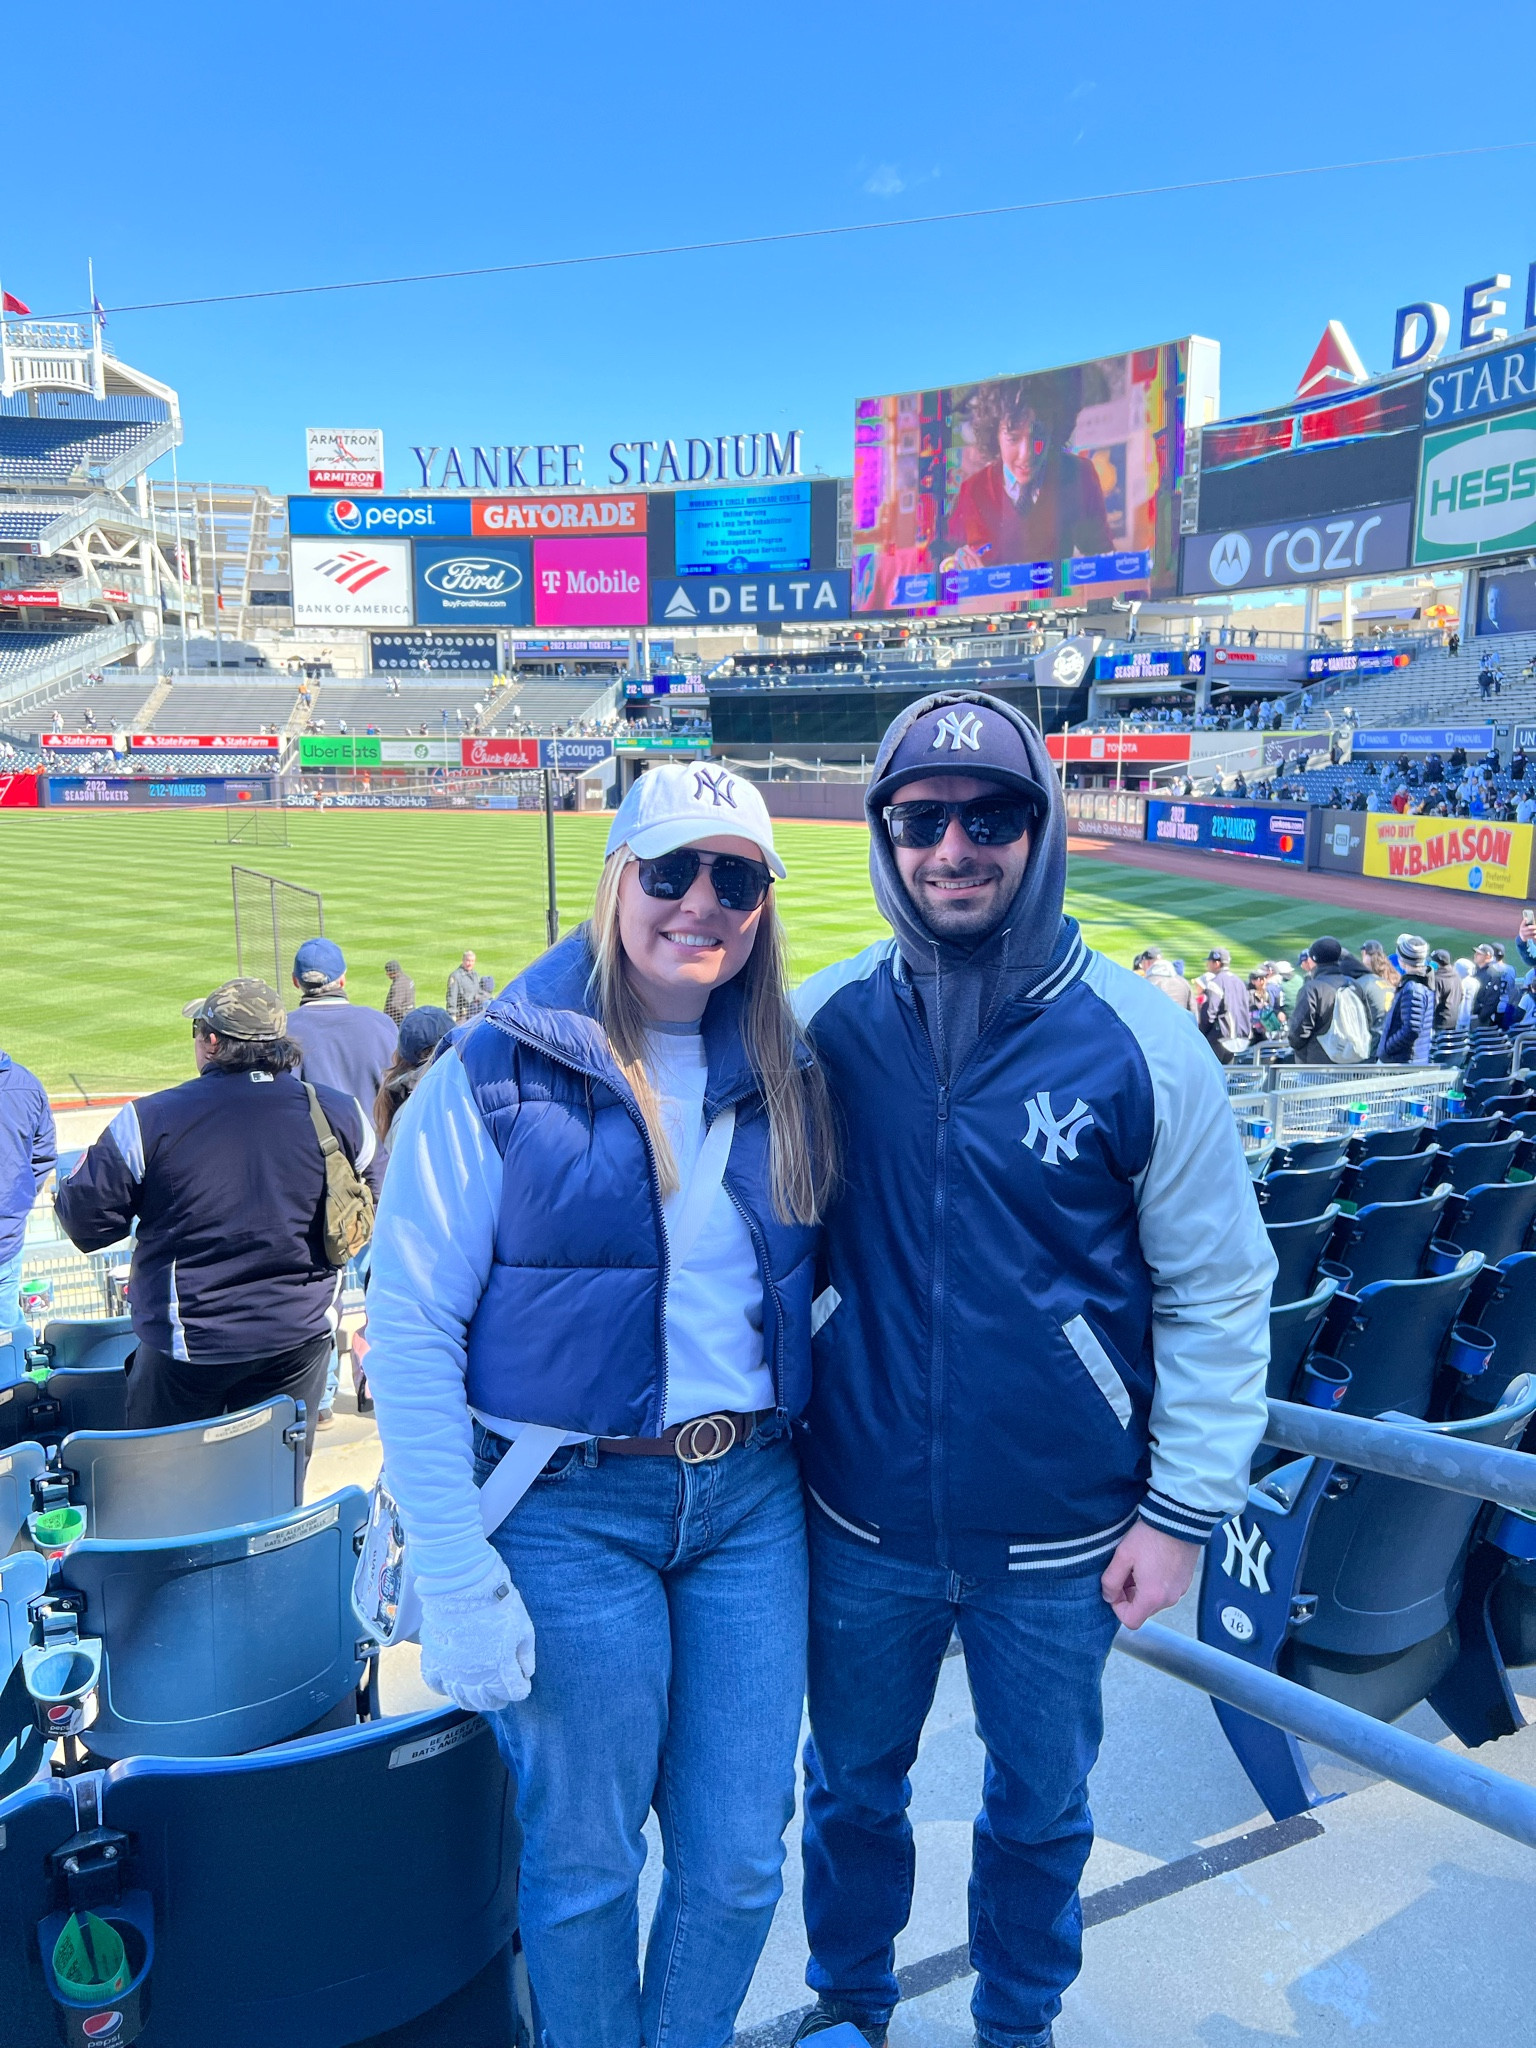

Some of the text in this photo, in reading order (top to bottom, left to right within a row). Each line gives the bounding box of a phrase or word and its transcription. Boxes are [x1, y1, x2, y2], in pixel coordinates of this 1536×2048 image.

[1392, 262, 1536, 370] DE
[1425, 348, 1536, 420] STAR
[310, 435, 377, 446] ARMITRON
[409, 429, 804, 489] YANKEE STADIUM
[314, 472, 375, 482] ARMITRON
[1430, 457, 1536, 517] HESS
[365, 505, 433, 529] pepsi
[483, 502, 636, 529] GATORADE
[1264, 515, 1382, 578] razr
[441, 562, 506, 591] Ford
[542, 570, 641, 593] T Mobile
[442, 599, 507, 608] BuyFordNow.com
[708, 581, 838, 613] DELTA
[298, 604, 410, 614] BANK OF AMERICA
[932, 711, 983, 750] NY
[303, 744, 339, 758] Uber
[342, 745, 378, 758] Eats
[565, 745, 605, 760] coupa
[1106, 742, 1138, 753] TOYOTA
[85, 781, 107, 791] 2023
[149, 784, 206, 797] 212-YANKEES
[693, 768, 738, 808] NY
[65, 791, 129, 801] SEASON TICKETS
[287, 795, 333, 806] Stubb
[336, 795, 381, 806] StubHub
[383, 796, 427, 806] StubHub
[1157, 820, 1177, 838] SEASON
[1378, 824, 1416, 839] WHO BUT
[1021, 1091, 1095, 1166] NY
[264, 1538, 282, 1547] BATS
[309, 1519, 327, 1532] BALLS
[286, 1524, 306, 1536] ALERT
[306, 1518, 318, 1527] FOR
[1221, 1515, 1272, 1594] NY
[1230, 1618, 1245, 1634] 16
[429, 1737, 442, 1746] BE
[443, 1724, 470, 1741] ALERT
[412, 1746, 436, 1758] BATS
[87, 2033, 121, 2048] pepsi
